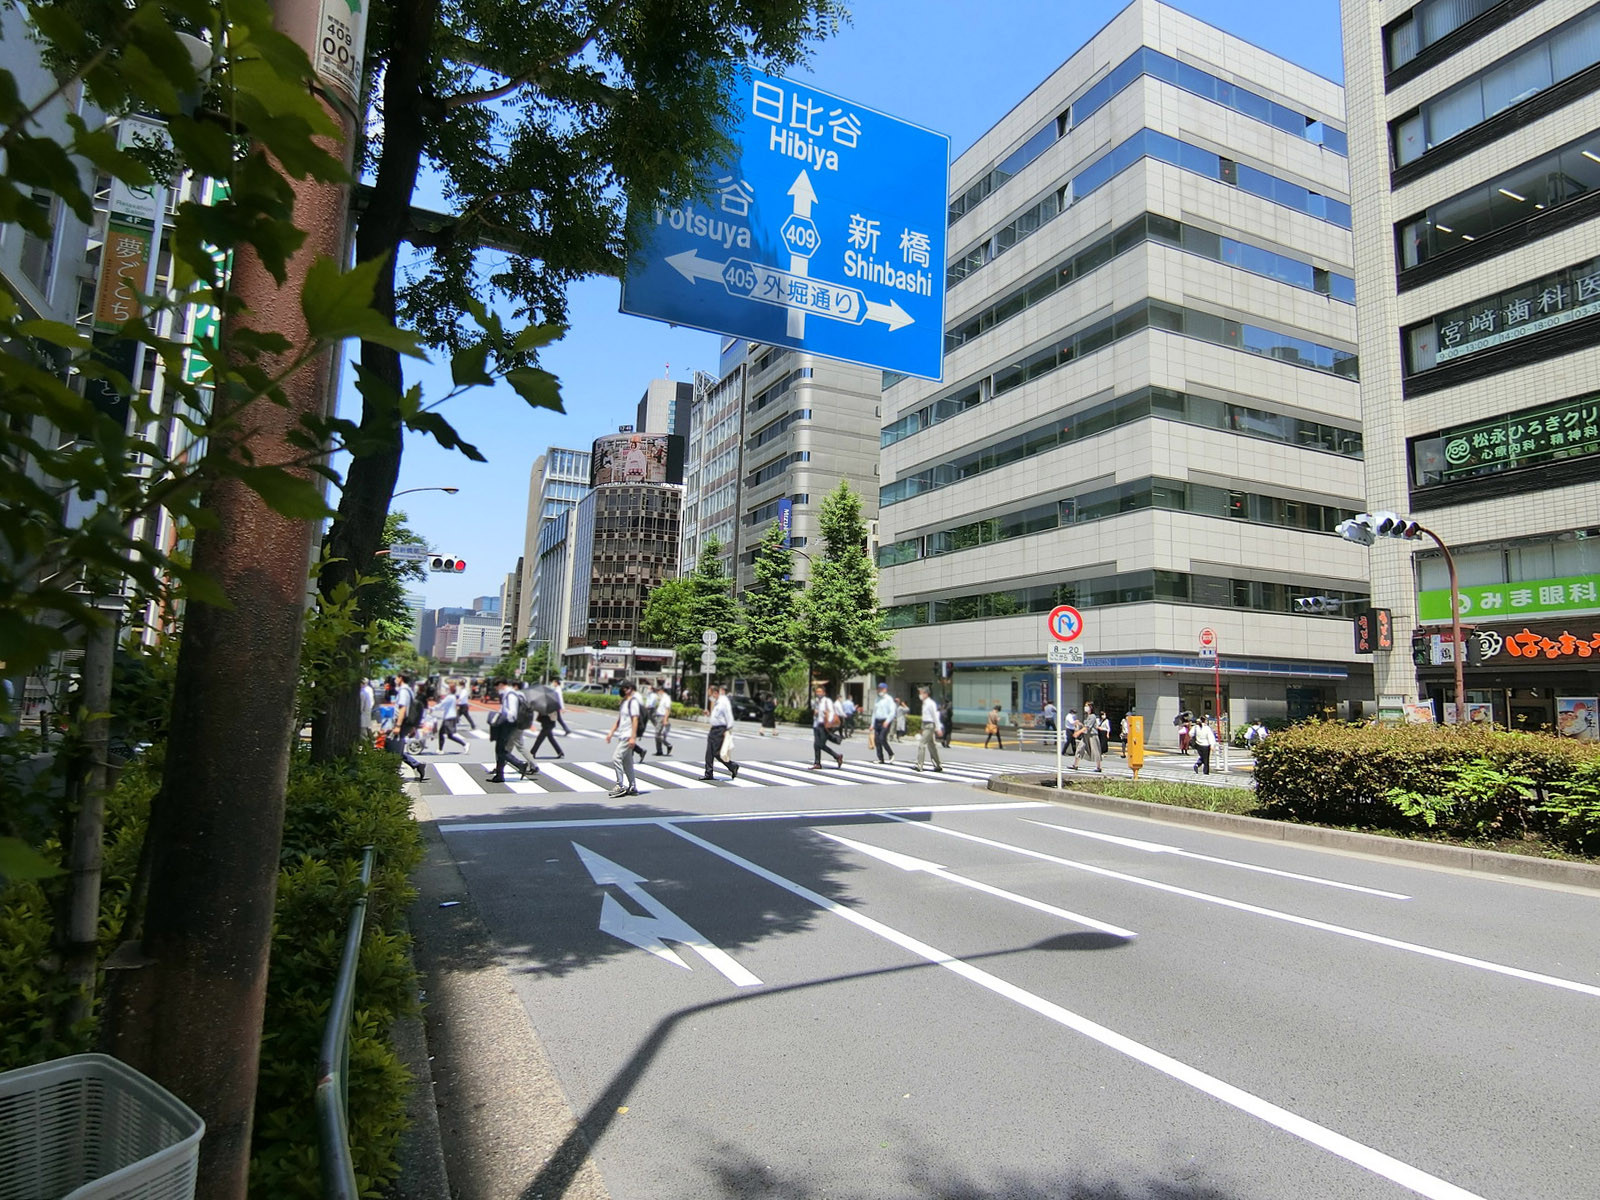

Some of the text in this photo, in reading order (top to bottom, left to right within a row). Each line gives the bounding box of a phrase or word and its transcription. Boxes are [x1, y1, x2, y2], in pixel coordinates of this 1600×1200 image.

[328, 24, 352, 46] 409
[752, 79, 862, 149] 日比谷
[769, 125, 839, 172] Hibiya
[126, 216, 142, 225] 4F
[786, 224, 816, 249] 409
[847, 213, 931, 268] 新橋
[725, 268, 853, 315] 405 外堀通り
[843, 250, 932, 297] Shinbashi
[1480, 582, 1597, 609] みま眼科
[1084, 658, 1111, 667] AWSON
